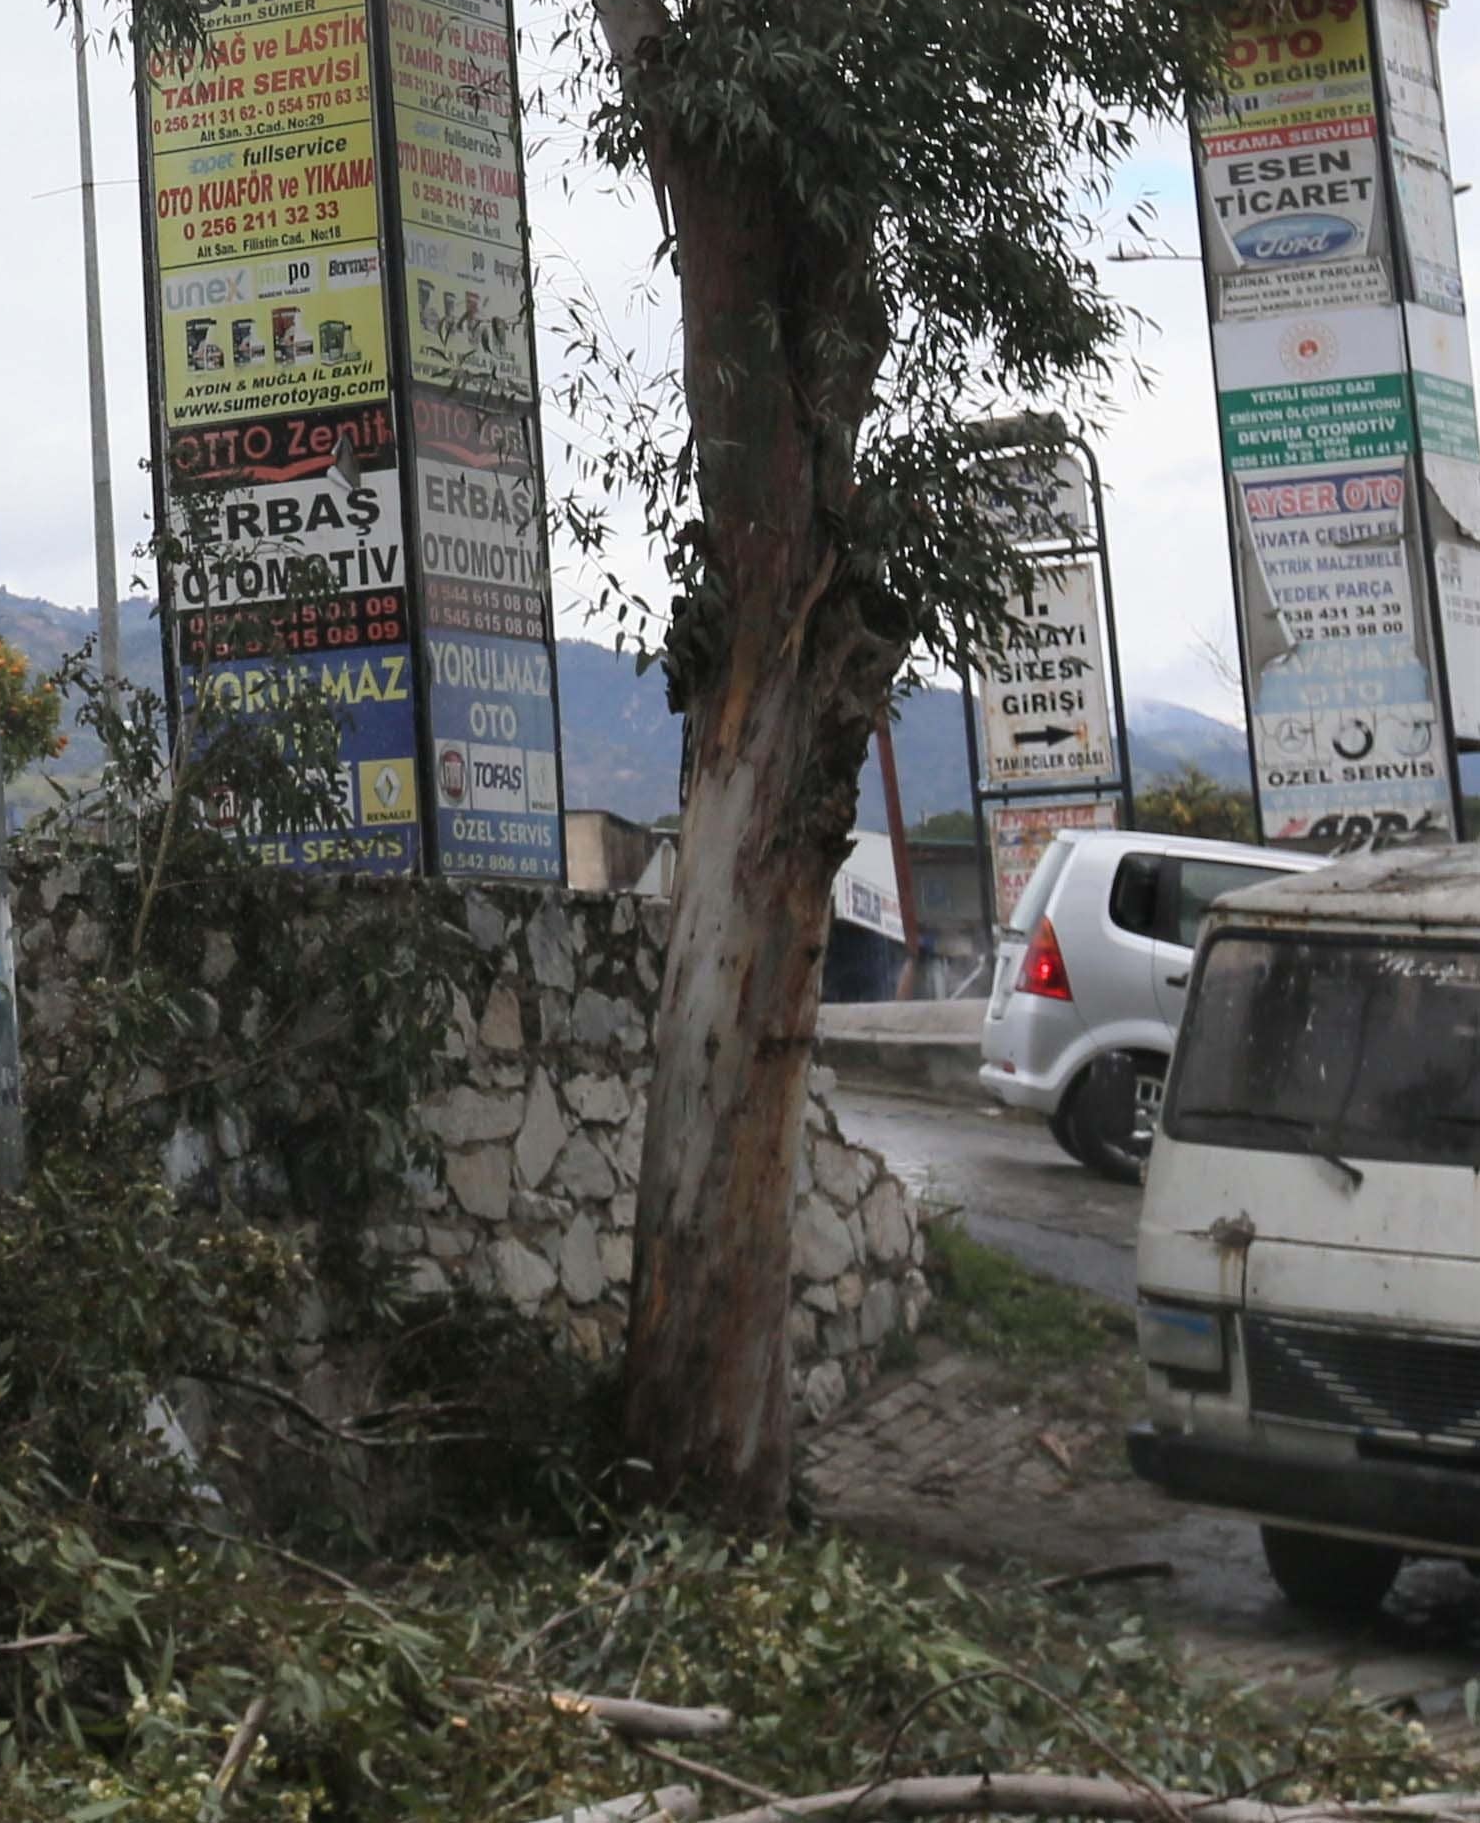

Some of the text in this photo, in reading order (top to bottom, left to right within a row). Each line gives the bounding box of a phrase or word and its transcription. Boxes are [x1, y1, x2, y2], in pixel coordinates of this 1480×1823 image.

[257, 0, 316, 20] SÜMER
[150, 46, 196, 78] OTO
[253, 38, 278, 61] ve
[285, 12, 367, 55] LASTİK
[388, 0, 414, 32] OTO
[464, 25, 509, 62] LASTİK
[396, 40, 443, 76] TAMİR
[1225, 29, 1324, 68] OTO
[161, 52, 360, 111] TAMİR SERVİSİ
[1254, 54, 1366, 88] DEĞİŞİMİ
[165, 116, 188, 133] 256
[192, 112, 215, 129] 211
[219, 109, 235, 125] 31
[266, 101, 274, 117] 0
[279, 97, 302, 113] 554
[307, 92, 331, 109] 570
[335, 88, 351, 104] 63
[200, 130, 214, 143] Alt
[243, 137, 347, 167] fullservice
[444, 127, 502, 159] fullservice
[1204, 133, 1282, 157] YIKAMA
[1288, 119, 1371, 145] SERVİSİ
[398, 139, 418, 171] OTO
[421, 146, 463, 185] KUAFÖR
[479, 164, 519, 199] YIKAMA
[1228, 149, 1351, 186] ESEN
[158, 158, 374, 218] OTO KUAFÖR ve YIKAMA
[446, 190, 465, 211] 211
[1214, 177, 1373, 218] TİCARET
[184, 201, 339, 240] 0 256 211 32 33
[197, 225, 341, 259] Alt San. Filistin Cad. No:18
[1255, 228, 1331, 258] Ford
[166, 269, 246, 311] unex
[185, 360, 373, 399] AYDIN & MUĞLA İL BAYİİ
[1250, 386, 1300, 405] YETKİLİ
[1345, 379, 1377, 396] GAZI
[173, 378, 386, 420] www.sumerotoyag.com
[1285, 401, 1331, 421] ÖLÇÜM
[1332, 396, 1402, 415] İSTASYONU
[413, 399, 470, 439] OTTO
[1238, 415, 1397, 447] DEVRİM OTOMOTİV
[174, 409, 394, 470] OTTO Zenith
[1260, 451, 1281, 467] 211
[1353, 442, 1374, 458] 411
[1377, 440, 1391, 454] 41
[1394, 439, 1408, 453] 34
[425, 473, 531, 537] ERBAŞ
[1246, 474, 1404, 519] AYSER OTO
[192, 487, 381, 545] ERBAŞ
[423, 532, 544, 591] OTOMOTİV
[1316, 550, 1403, 571] MALZEMELE
[366, 596, 398, 617] 09
[473, 591, 499, 610] 615
[503, 594, 521, 613] 08
[525, 596, 542, 616] 09
[1273, 580, 1394, 603] YEDEK PARÇA
[443, 608, 470, 628] 545
[475, 612, 502, 633] 615
[505, 617, 523, 635] 08
[527, 620, 543, 639] 09
[1319, 602, 1402, 620] 431 34 39
[1356, 622, 1378, 636] 98
[1383, 620, 1403, 634] 00
[367, 622, 400, 642] 09
[1006, 624, 1087, 651] ANAYİ
[428, 640, 551, 697] YORULMAZ
[1001, 688, 1085, 718] GİRİŞİ
[470, 701, 517, 741] OTO
[996, 749, 1105, 772] TAMİRCİLER ODASI
[1267, 767, 1334, 788] ÖZEL
[1342, 760, 1436, 783] SERVİS
[473, 762, 522, 795] TOFAŞ
[453, 812, 553, 847] ÖZEL SERVİS
[443, 852, 453, 868] 0
